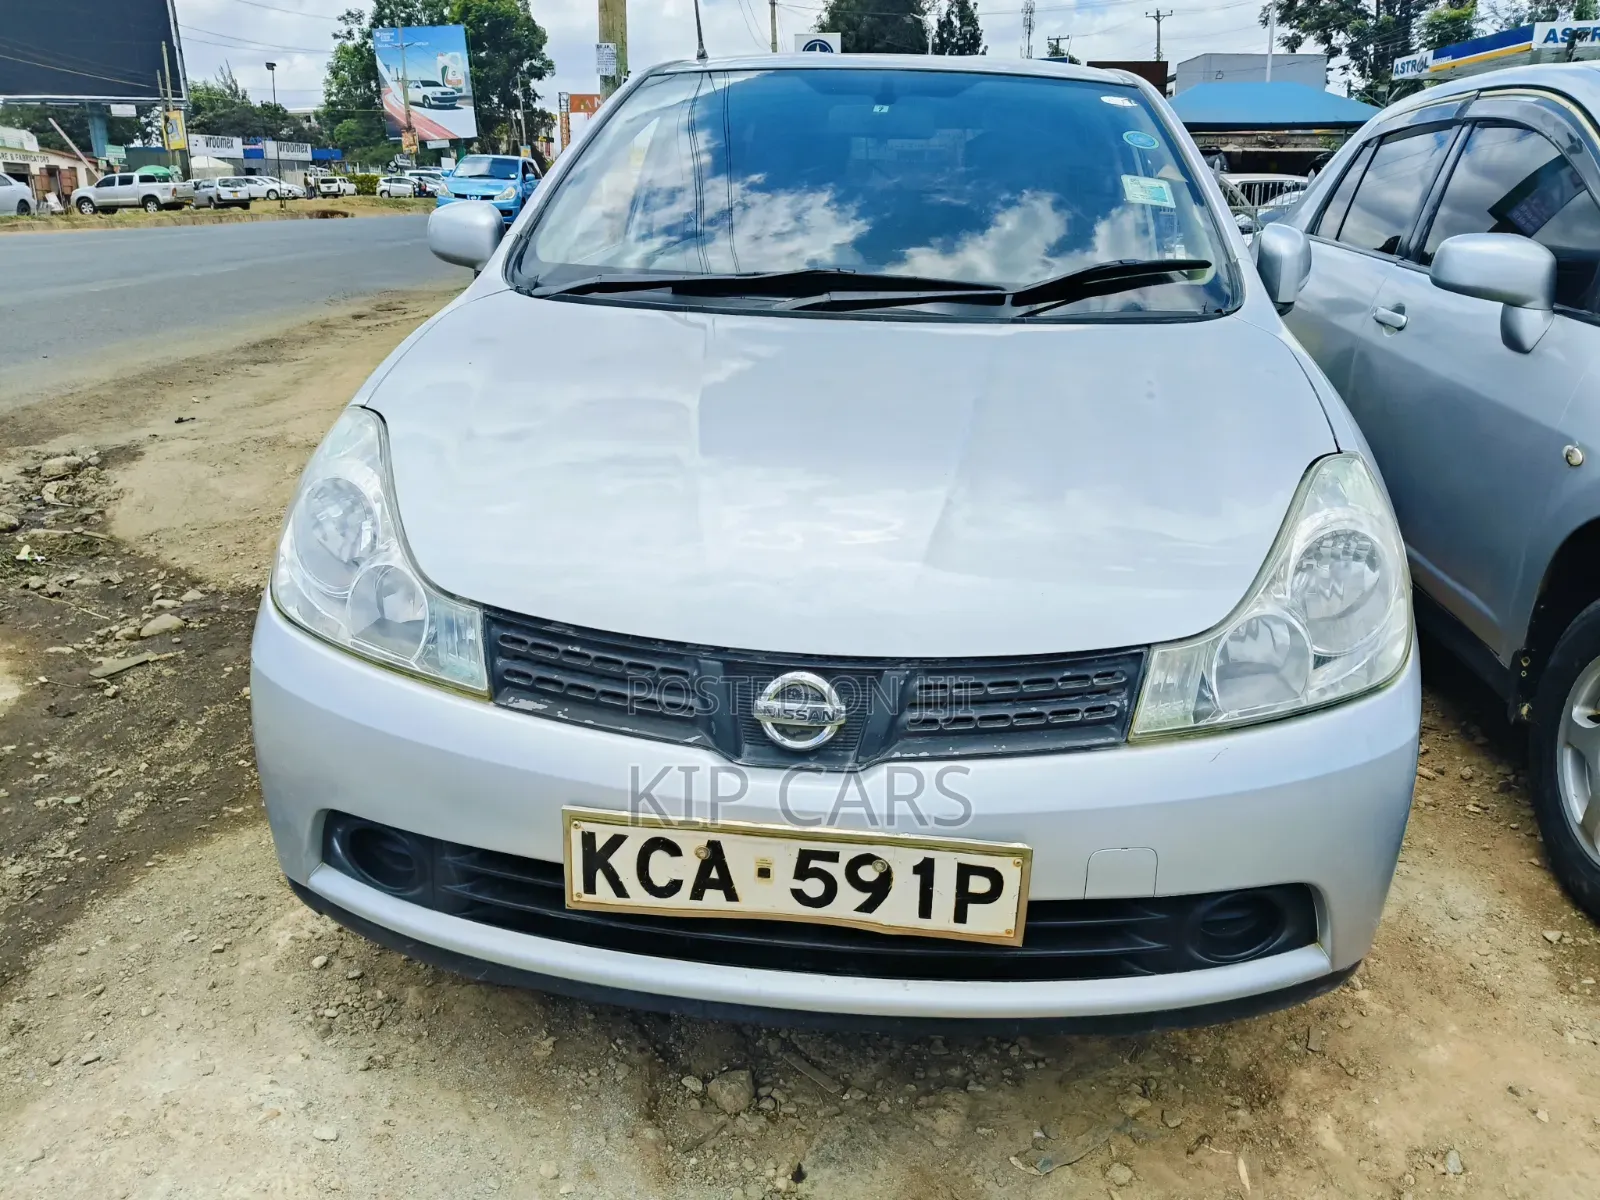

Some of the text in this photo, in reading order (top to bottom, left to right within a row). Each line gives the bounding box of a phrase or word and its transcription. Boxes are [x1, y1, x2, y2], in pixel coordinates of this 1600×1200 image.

[1394, 55, 1429, 76] ASTROL
[204, 135, 234, 150] vroomex
[279, 141, 309, 154] vroomex
[763, 705, 836, 722] NISSAN
[580, 831, 1005, 925] KCA 591P
